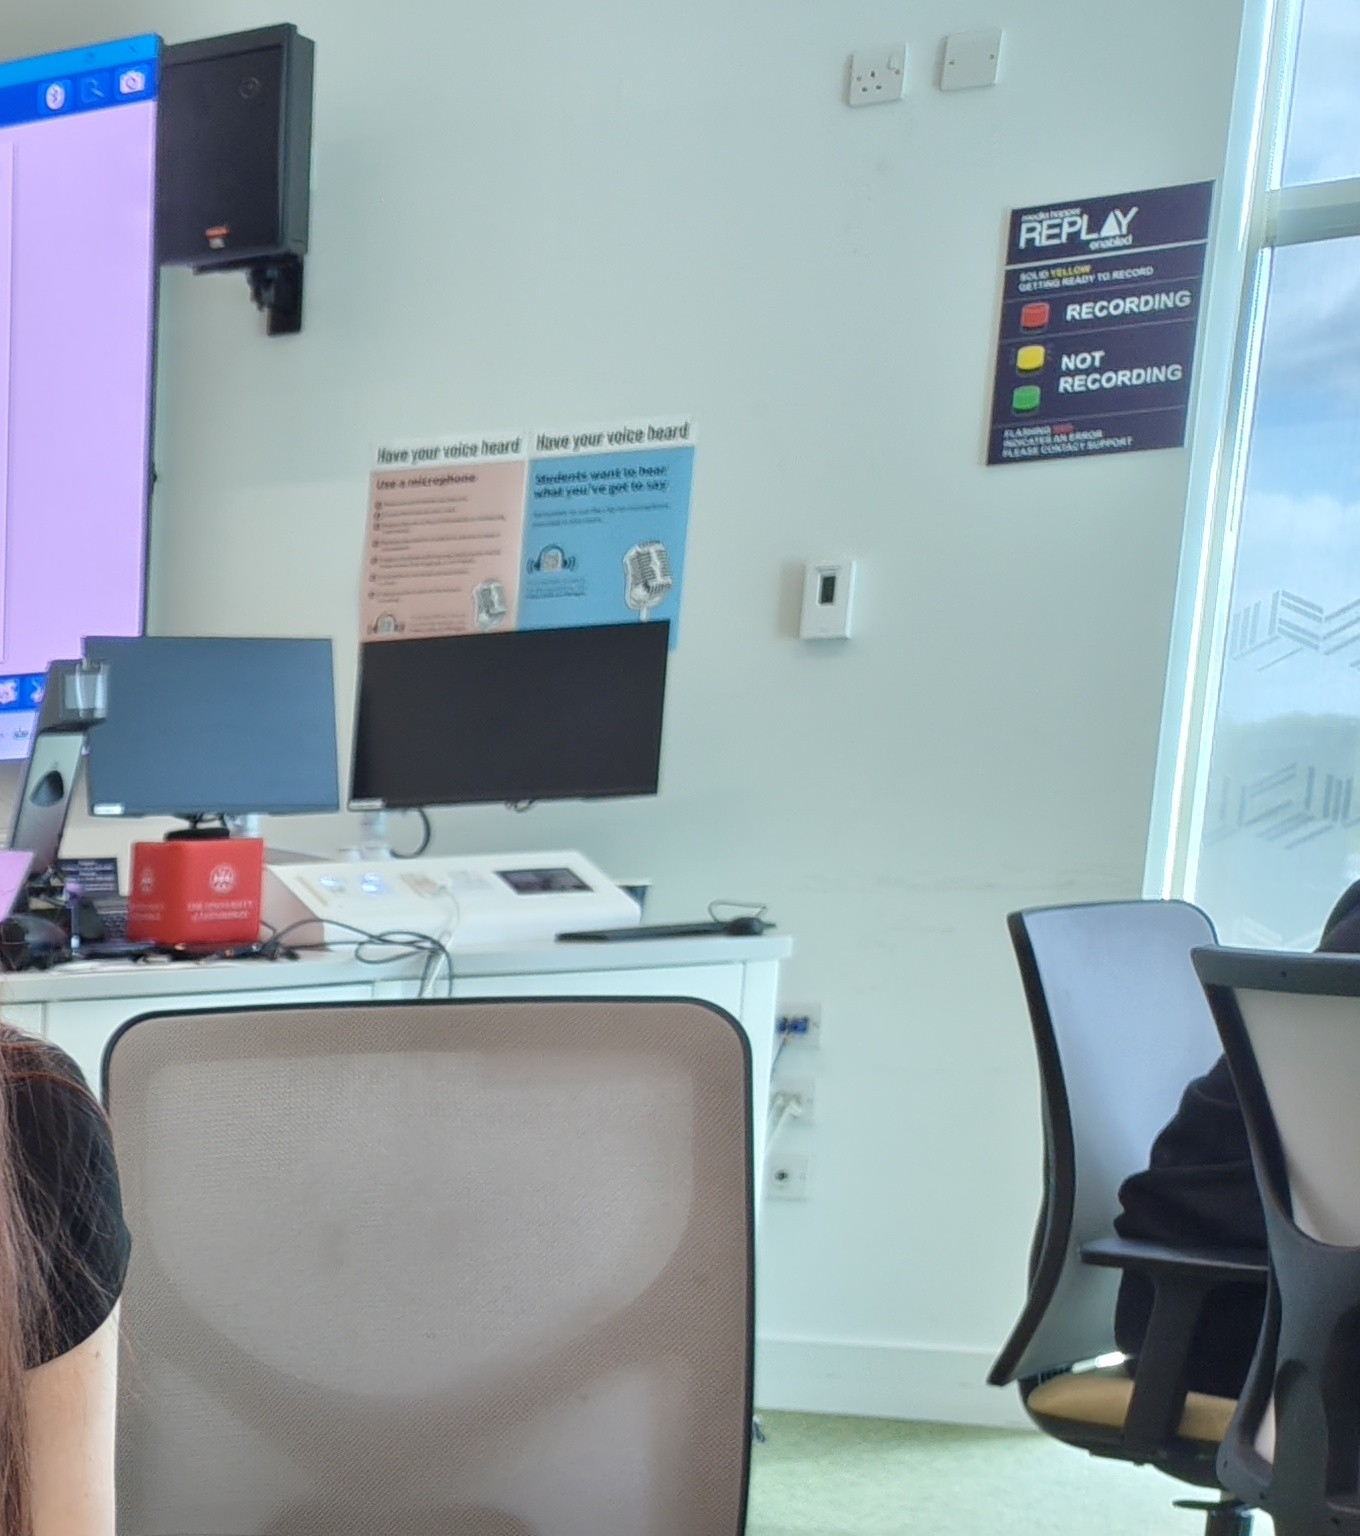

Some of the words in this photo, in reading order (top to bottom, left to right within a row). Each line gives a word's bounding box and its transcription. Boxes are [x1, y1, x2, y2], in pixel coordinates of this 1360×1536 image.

[1019, 206, 1139, 250] REPLAY
[1018, 279, 1060, 292] GETTING
[1062, 274, 1095, 287] READY
[1097, 272, 1111, 281] TO
[1112, 265, 1154, 280] RECORD
[1050, 265, 1091, 277] YELLOW
[1066, 290, 1192, 321] RECORDING
[1061, 350, 1105, 372] NOT
[1058, 364, 1183, 394] RECORDING
[536, 433, 569, 450] Have
[573, 432, 603, 451] your
[607, 426, 645, 445] voice
[646, 421, 691, 440] heard
[377, 448, 409, 464] Have
[411, 447, 440, 465] your
[443, 441, 478, 459] voice
[480, 435, 522, 455] heard
[376, 480, 396, 490] Use
[408, 473, 477, 487] microphone
[535, 471, 587, 483] Students
[590, 467, 621, 480] want
[624, 466, 636, 476] to
[630, 480, 643, 489] to
